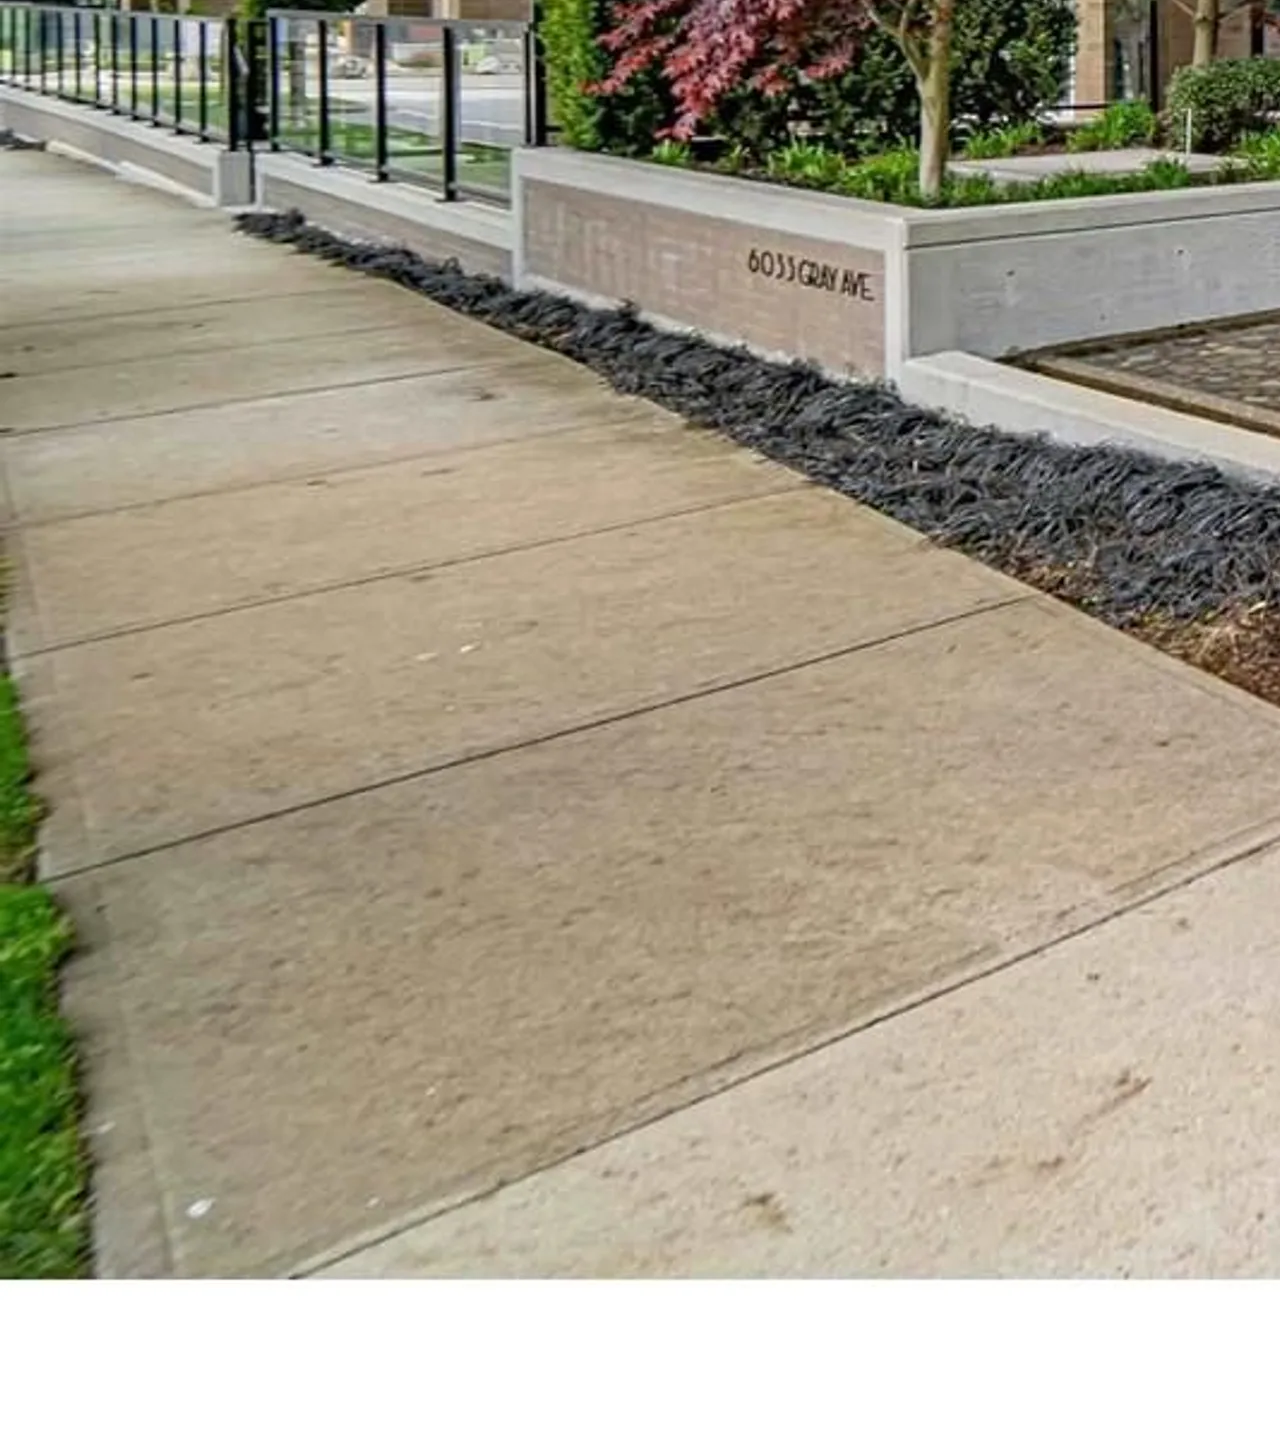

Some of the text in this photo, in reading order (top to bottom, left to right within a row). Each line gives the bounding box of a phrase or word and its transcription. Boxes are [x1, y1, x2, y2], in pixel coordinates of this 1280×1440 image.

[748, 249, 875, 301] 6033 GRAY AVE
